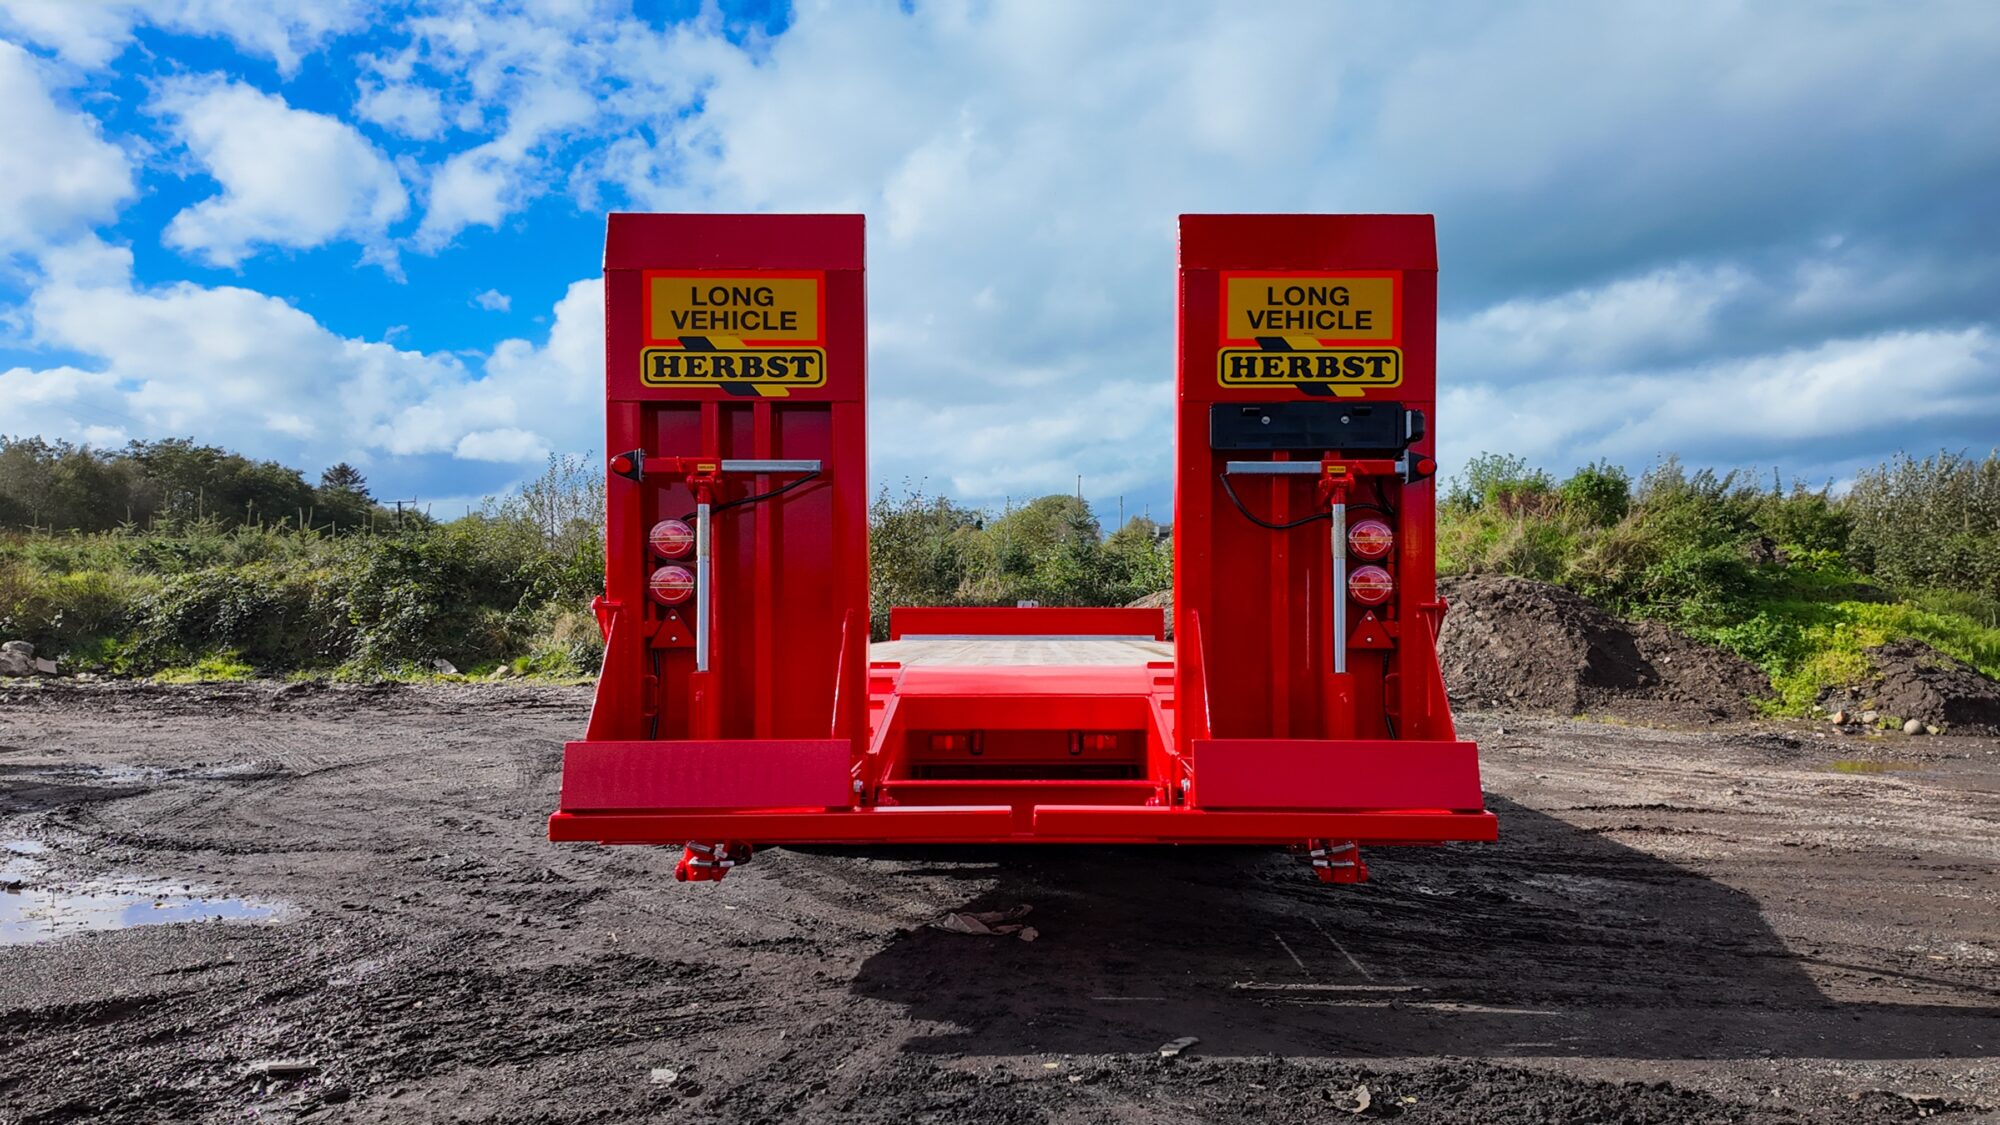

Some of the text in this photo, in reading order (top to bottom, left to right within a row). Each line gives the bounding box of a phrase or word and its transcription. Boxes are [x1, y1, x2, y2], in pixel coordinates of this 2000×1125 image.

[691, 286, 774, 307] LONG
[1267, 286, 1350, 306] LONG
[671, 310, 797, 331] VEHICLE
[1246, 309, 1373, 330] VEHICLE
[653, 355, 815, 378] HERBST
[1230, 355, 1391, 378] HERBST
